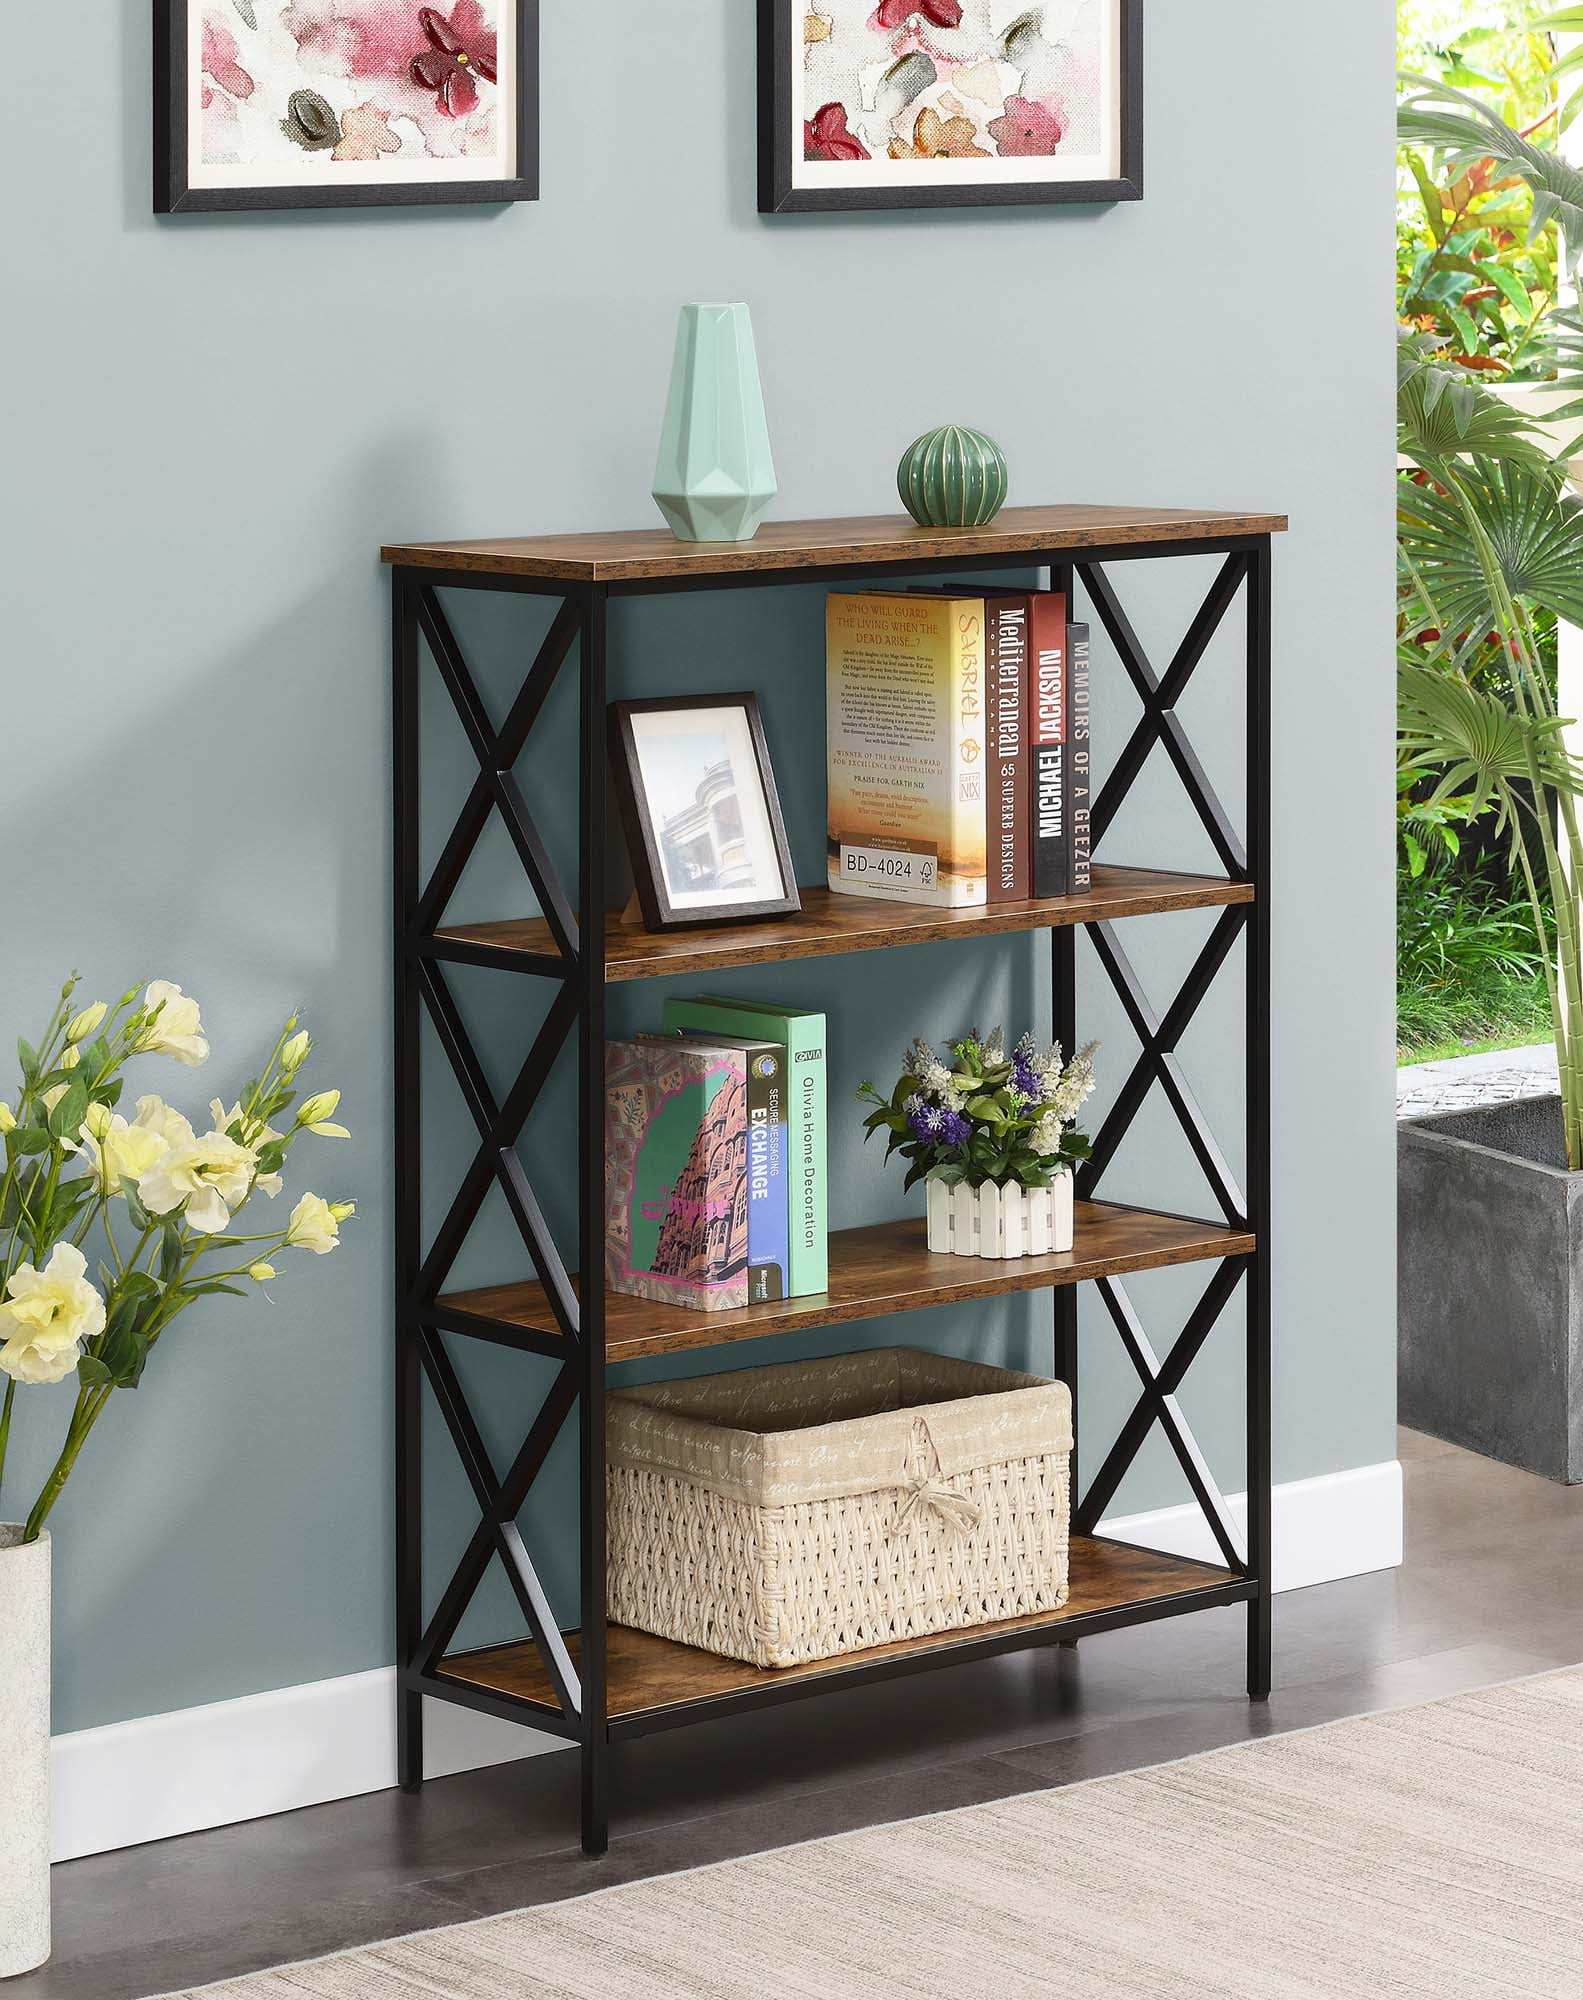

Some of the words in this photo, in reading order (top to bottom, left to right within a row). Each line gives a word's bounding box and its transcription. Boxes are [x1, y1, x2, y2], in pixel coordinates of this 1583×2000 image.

[837, 616, 855, 628] THE
[857, 618, 888, 631] LIVING
[891, 621, 918, 634] WHEN
[919, 623, 938, 635] THE
[846, 603, 869, 615] WHO
[870, 605, 893, 617] WILL
[895, 607, 928, 619] GUARD
[856, 632, 882, 645] DEAD
[999, 608, 1025, 758] Mediterranean
[1039, 649, 1062, 742] JACKSON
[1074, 641, 1089, 740] MEMOIRS
[853, 775, 875, 784] PRAISE
[876, 777, 890, 785] FOR
[1001, 763, 1015, 777] 65
[1074, 751, 1089, 775] OF
[1001, 780, 1014, 829] SUPERB
[1039, 744, 1062, 838] MICHAEL
[1074, 787, 1089, 798] A
[847, 854, 912, 878] BD-4024
[1001, 833, 1014, 890] DESIGNS
[1074, 808, 1090, 886] GEEZER
[769, 1088, 779, 1124] SECURE
[803, 1077, 814, 1119] Olivia
[751, 1107, 768, 1200] EXCHANGE
[769, 1124, 779, 1176] MESSAGING
[803, 1123, 815, 1164] Home
[804, 1167, 817, 1248] Decoration
